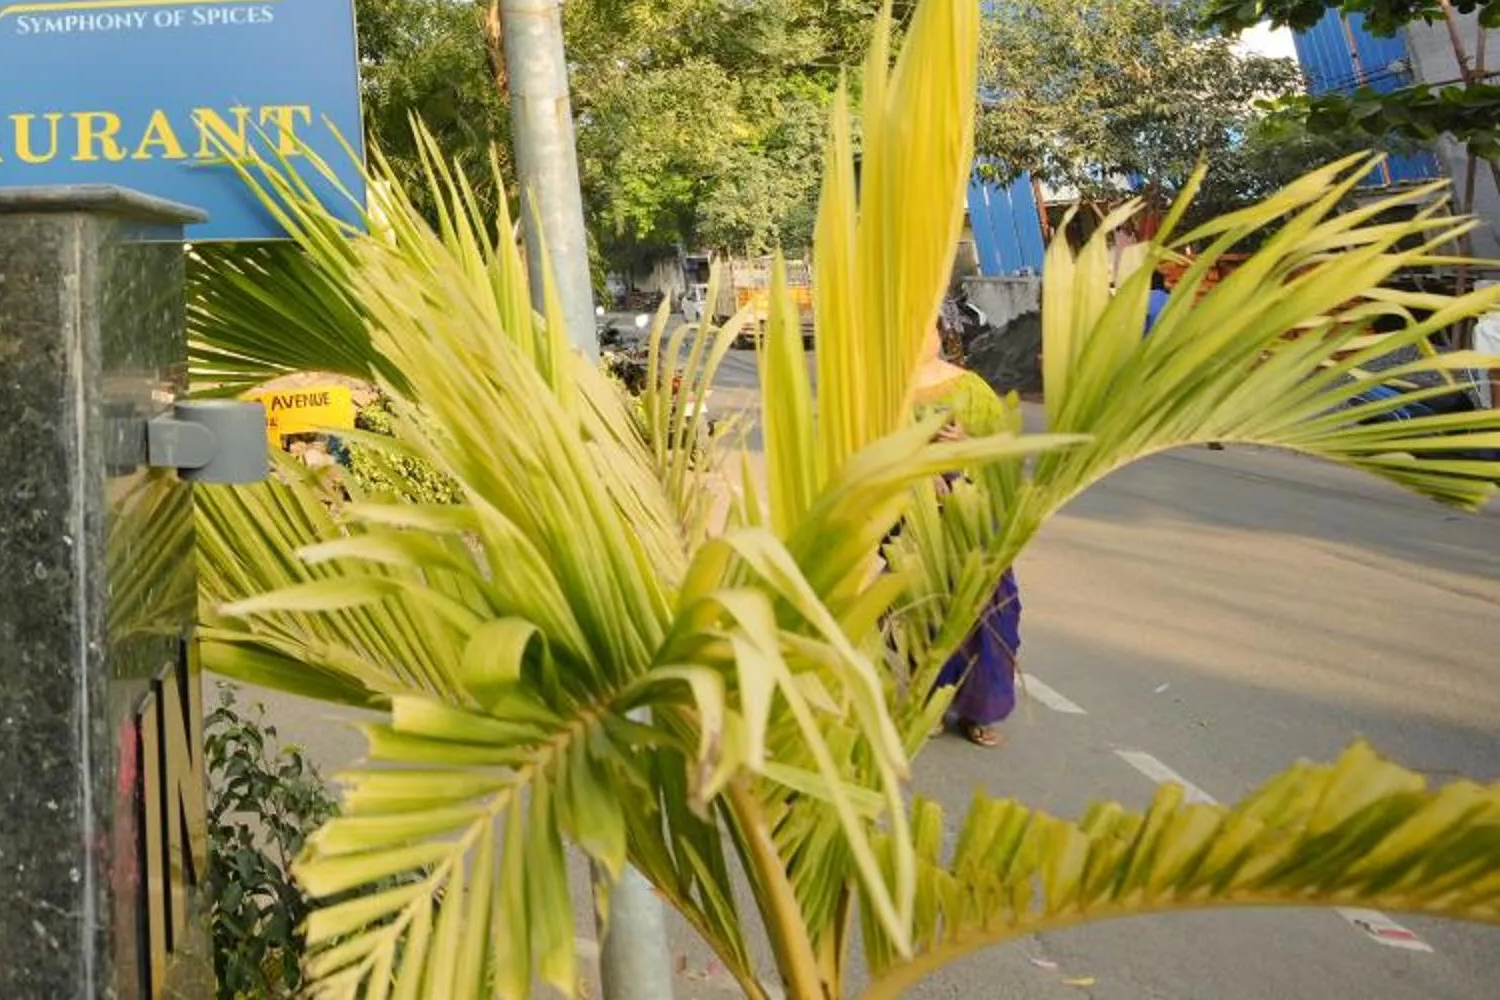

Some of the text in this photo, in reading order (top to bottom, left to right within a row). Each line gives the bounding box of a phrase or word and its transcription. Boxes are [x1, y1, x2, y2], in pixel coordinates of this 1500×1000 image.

[15, 5, 275, 35] SYMPHONY OF SPICES
[271, 391, 332, 412] AVENUE
